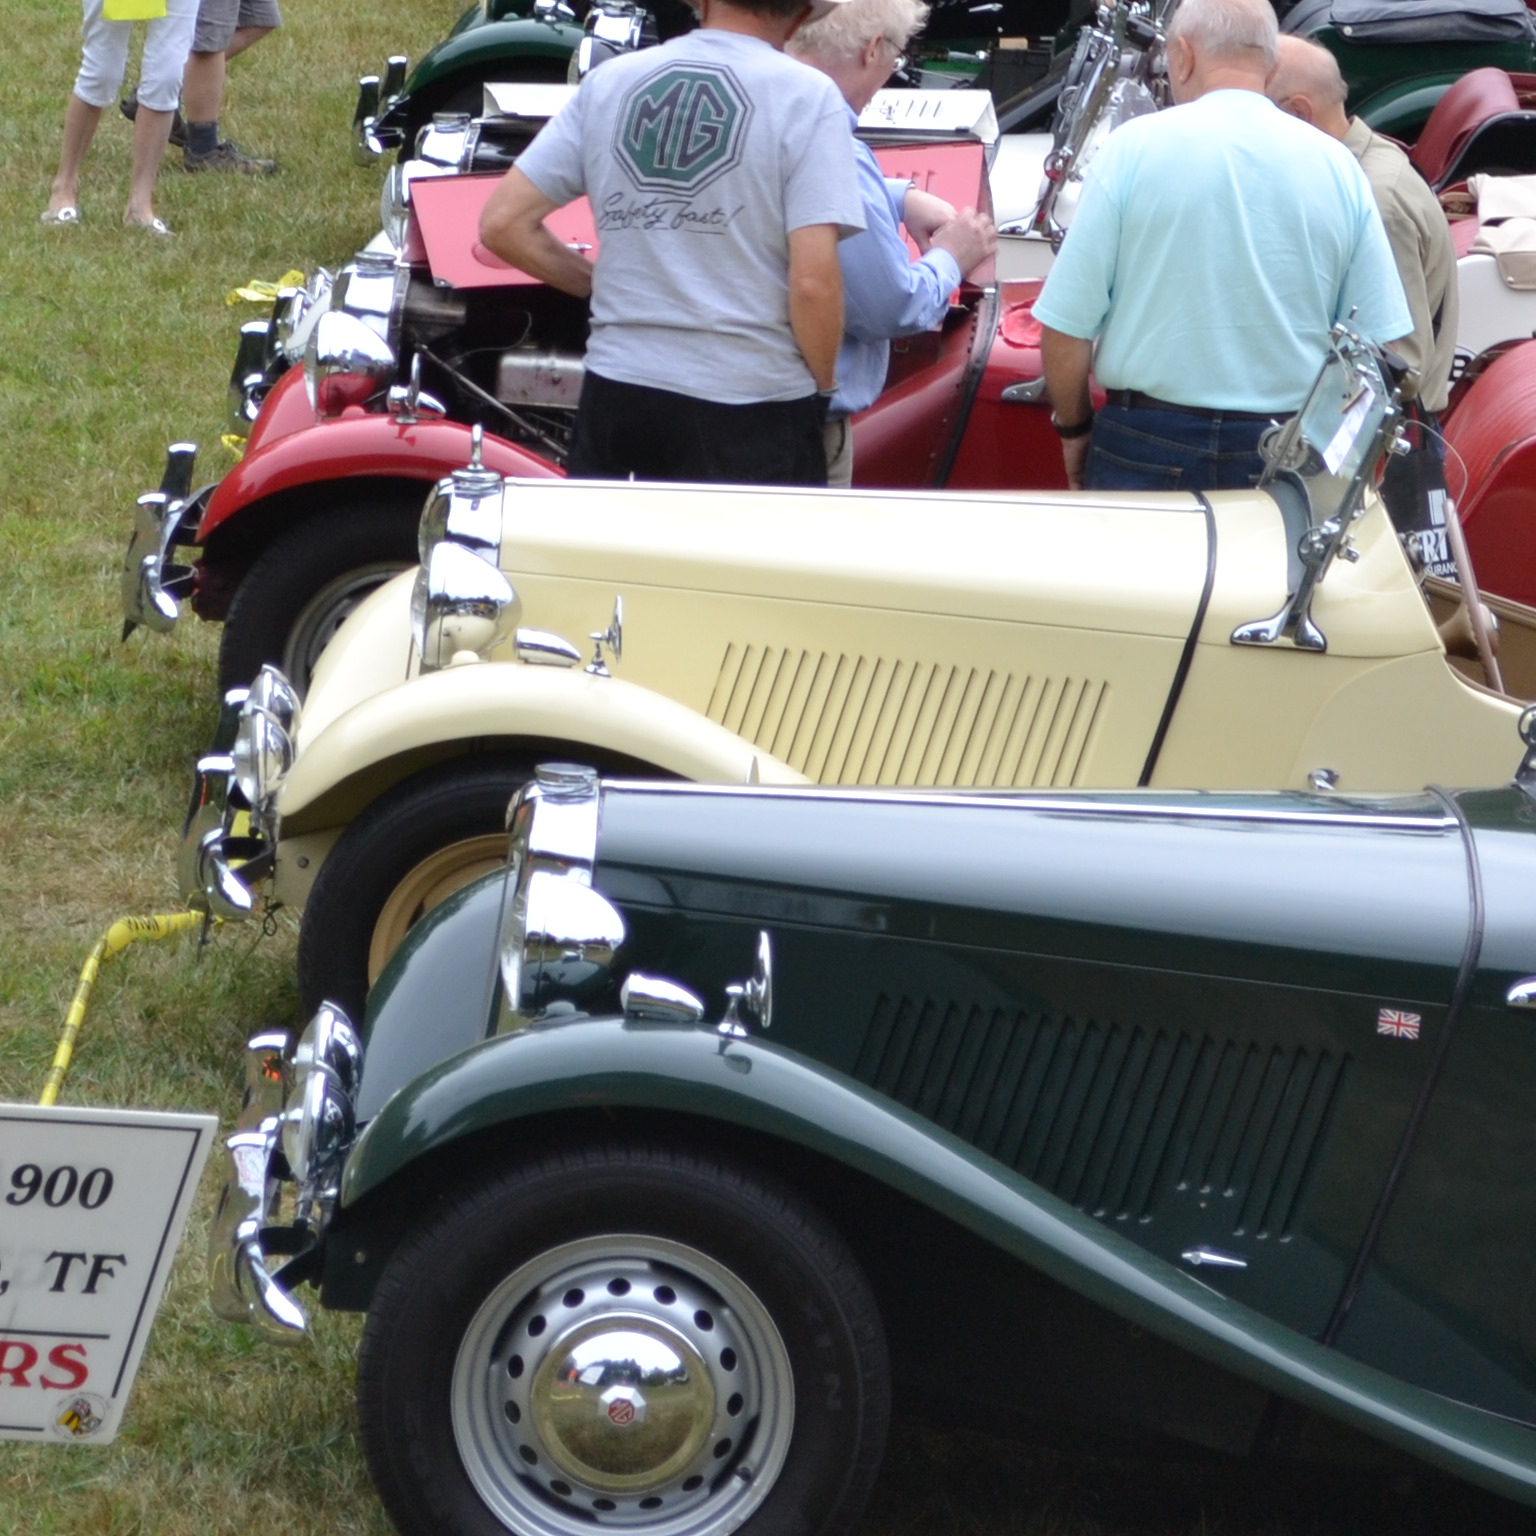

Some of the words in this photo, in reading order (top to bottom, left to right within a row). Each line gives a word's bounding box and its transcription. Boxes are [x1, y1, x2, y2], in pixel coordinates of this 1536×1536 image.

[629, 78, 729, 171] MG
[5, 1164, 114, 1210] 900
[42, 1250, 127, 1295] TF
